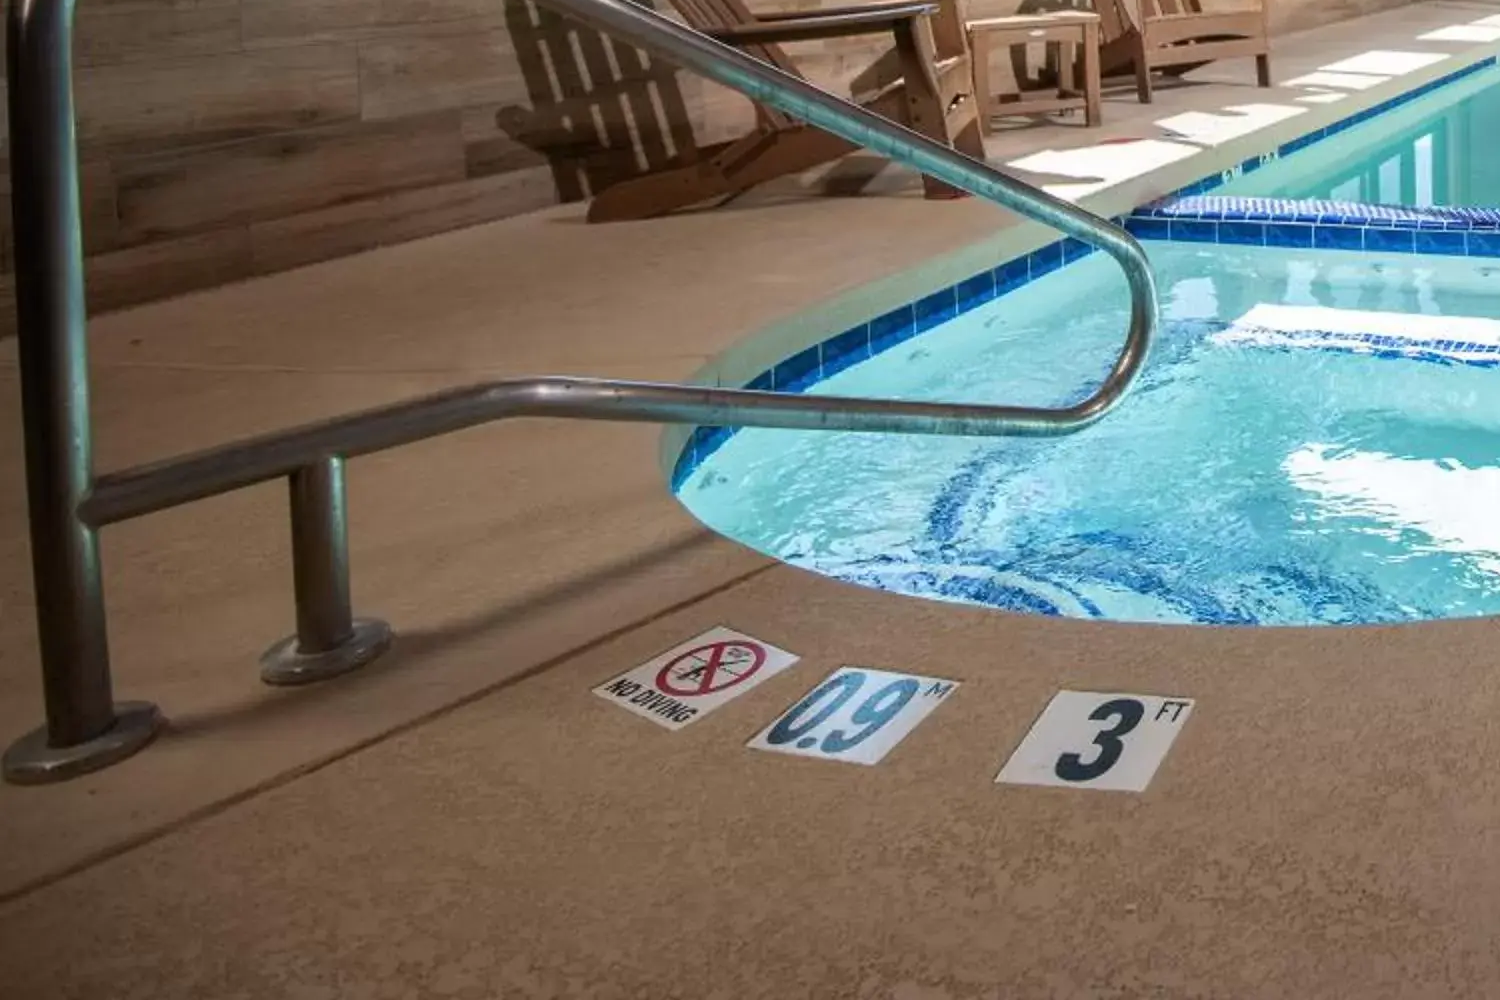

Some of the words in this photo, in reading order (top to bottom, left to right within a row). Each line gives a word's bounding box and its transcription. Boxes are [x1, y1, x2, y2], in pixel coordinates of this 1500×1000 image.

[604, 678, 638, 698] NO
[628, 688, 699, 723] DIVING
[767, 671, 920, 753] 0.9
[924, 682, 953, 699] M
[1055, 699, 1145, 781] 3
[1153, 701, 1190, 722] FT
